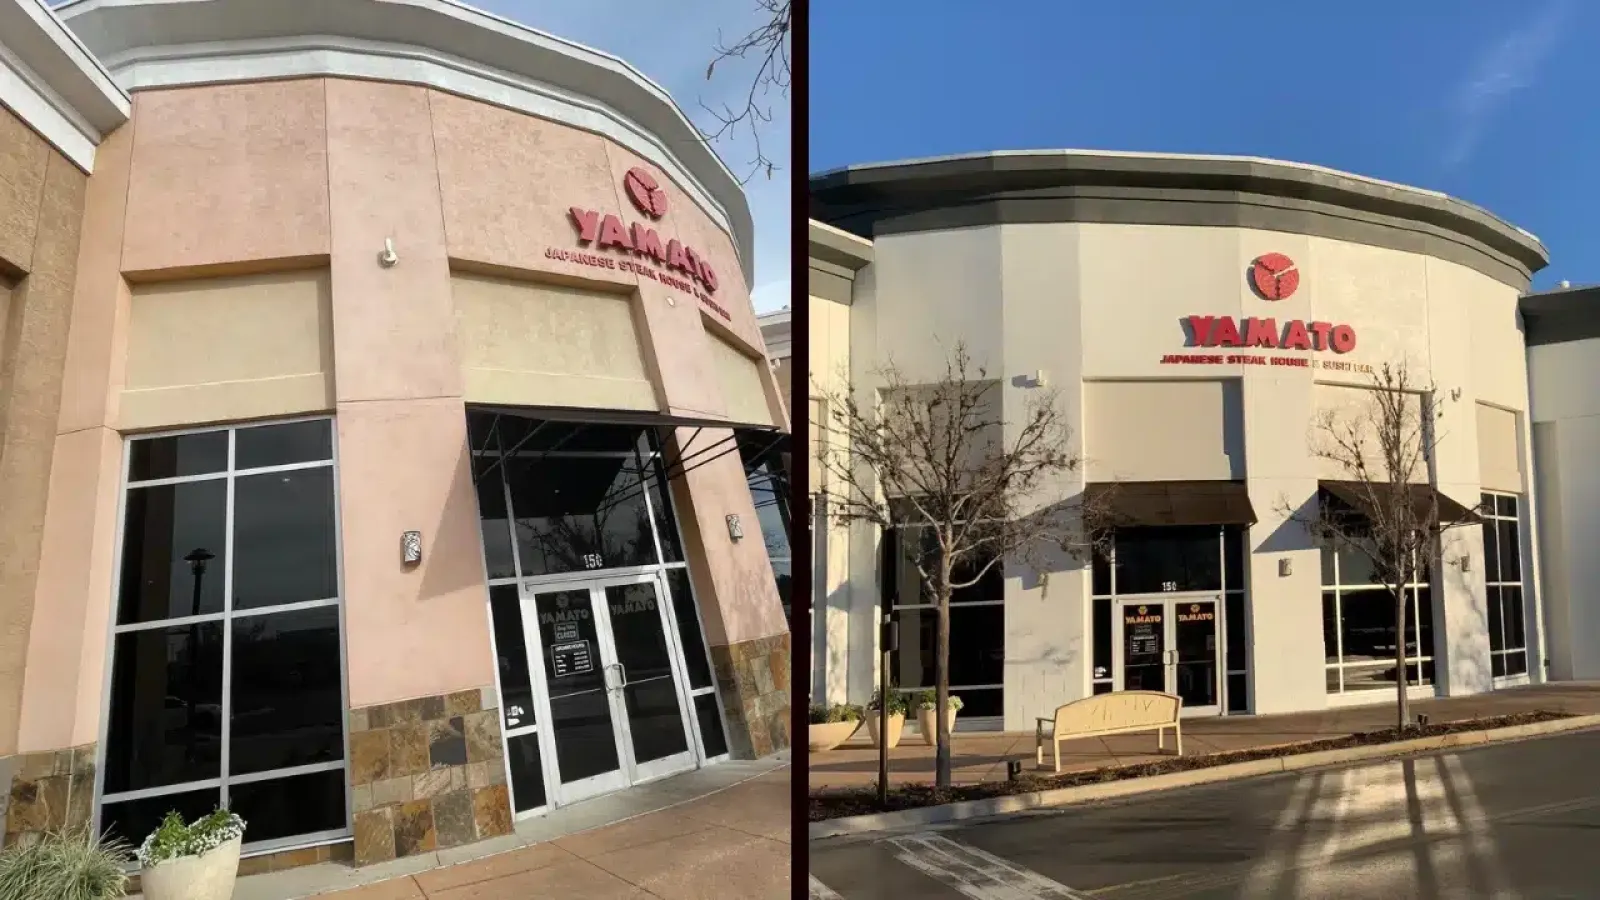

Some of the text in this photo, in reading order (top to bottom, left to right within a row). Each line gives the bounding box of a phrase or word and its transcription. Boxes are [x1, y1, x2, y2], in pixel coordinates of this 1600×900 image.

[568, 206, 719, 292] YAMATO
[545, 248, 616, 270] JAPANESE
[619, 260, 657, 281] STEAK
[1188, 315, 1357, 353] YAMATO
[1160, 354, 1223, 365] JAPANESE
[1227, 355, 1267, 366] STEAK
[1270, 357, 1309, 368] HOUSE
[1161, 581, 1177, 591] 150
[611, 599, 655, 616] YAMATO
[540, 608, 590, 625] YAMATO
[1125, 615, 1161, 624] YAMATO
[1178, 613, 1213, 622] YAMATO
